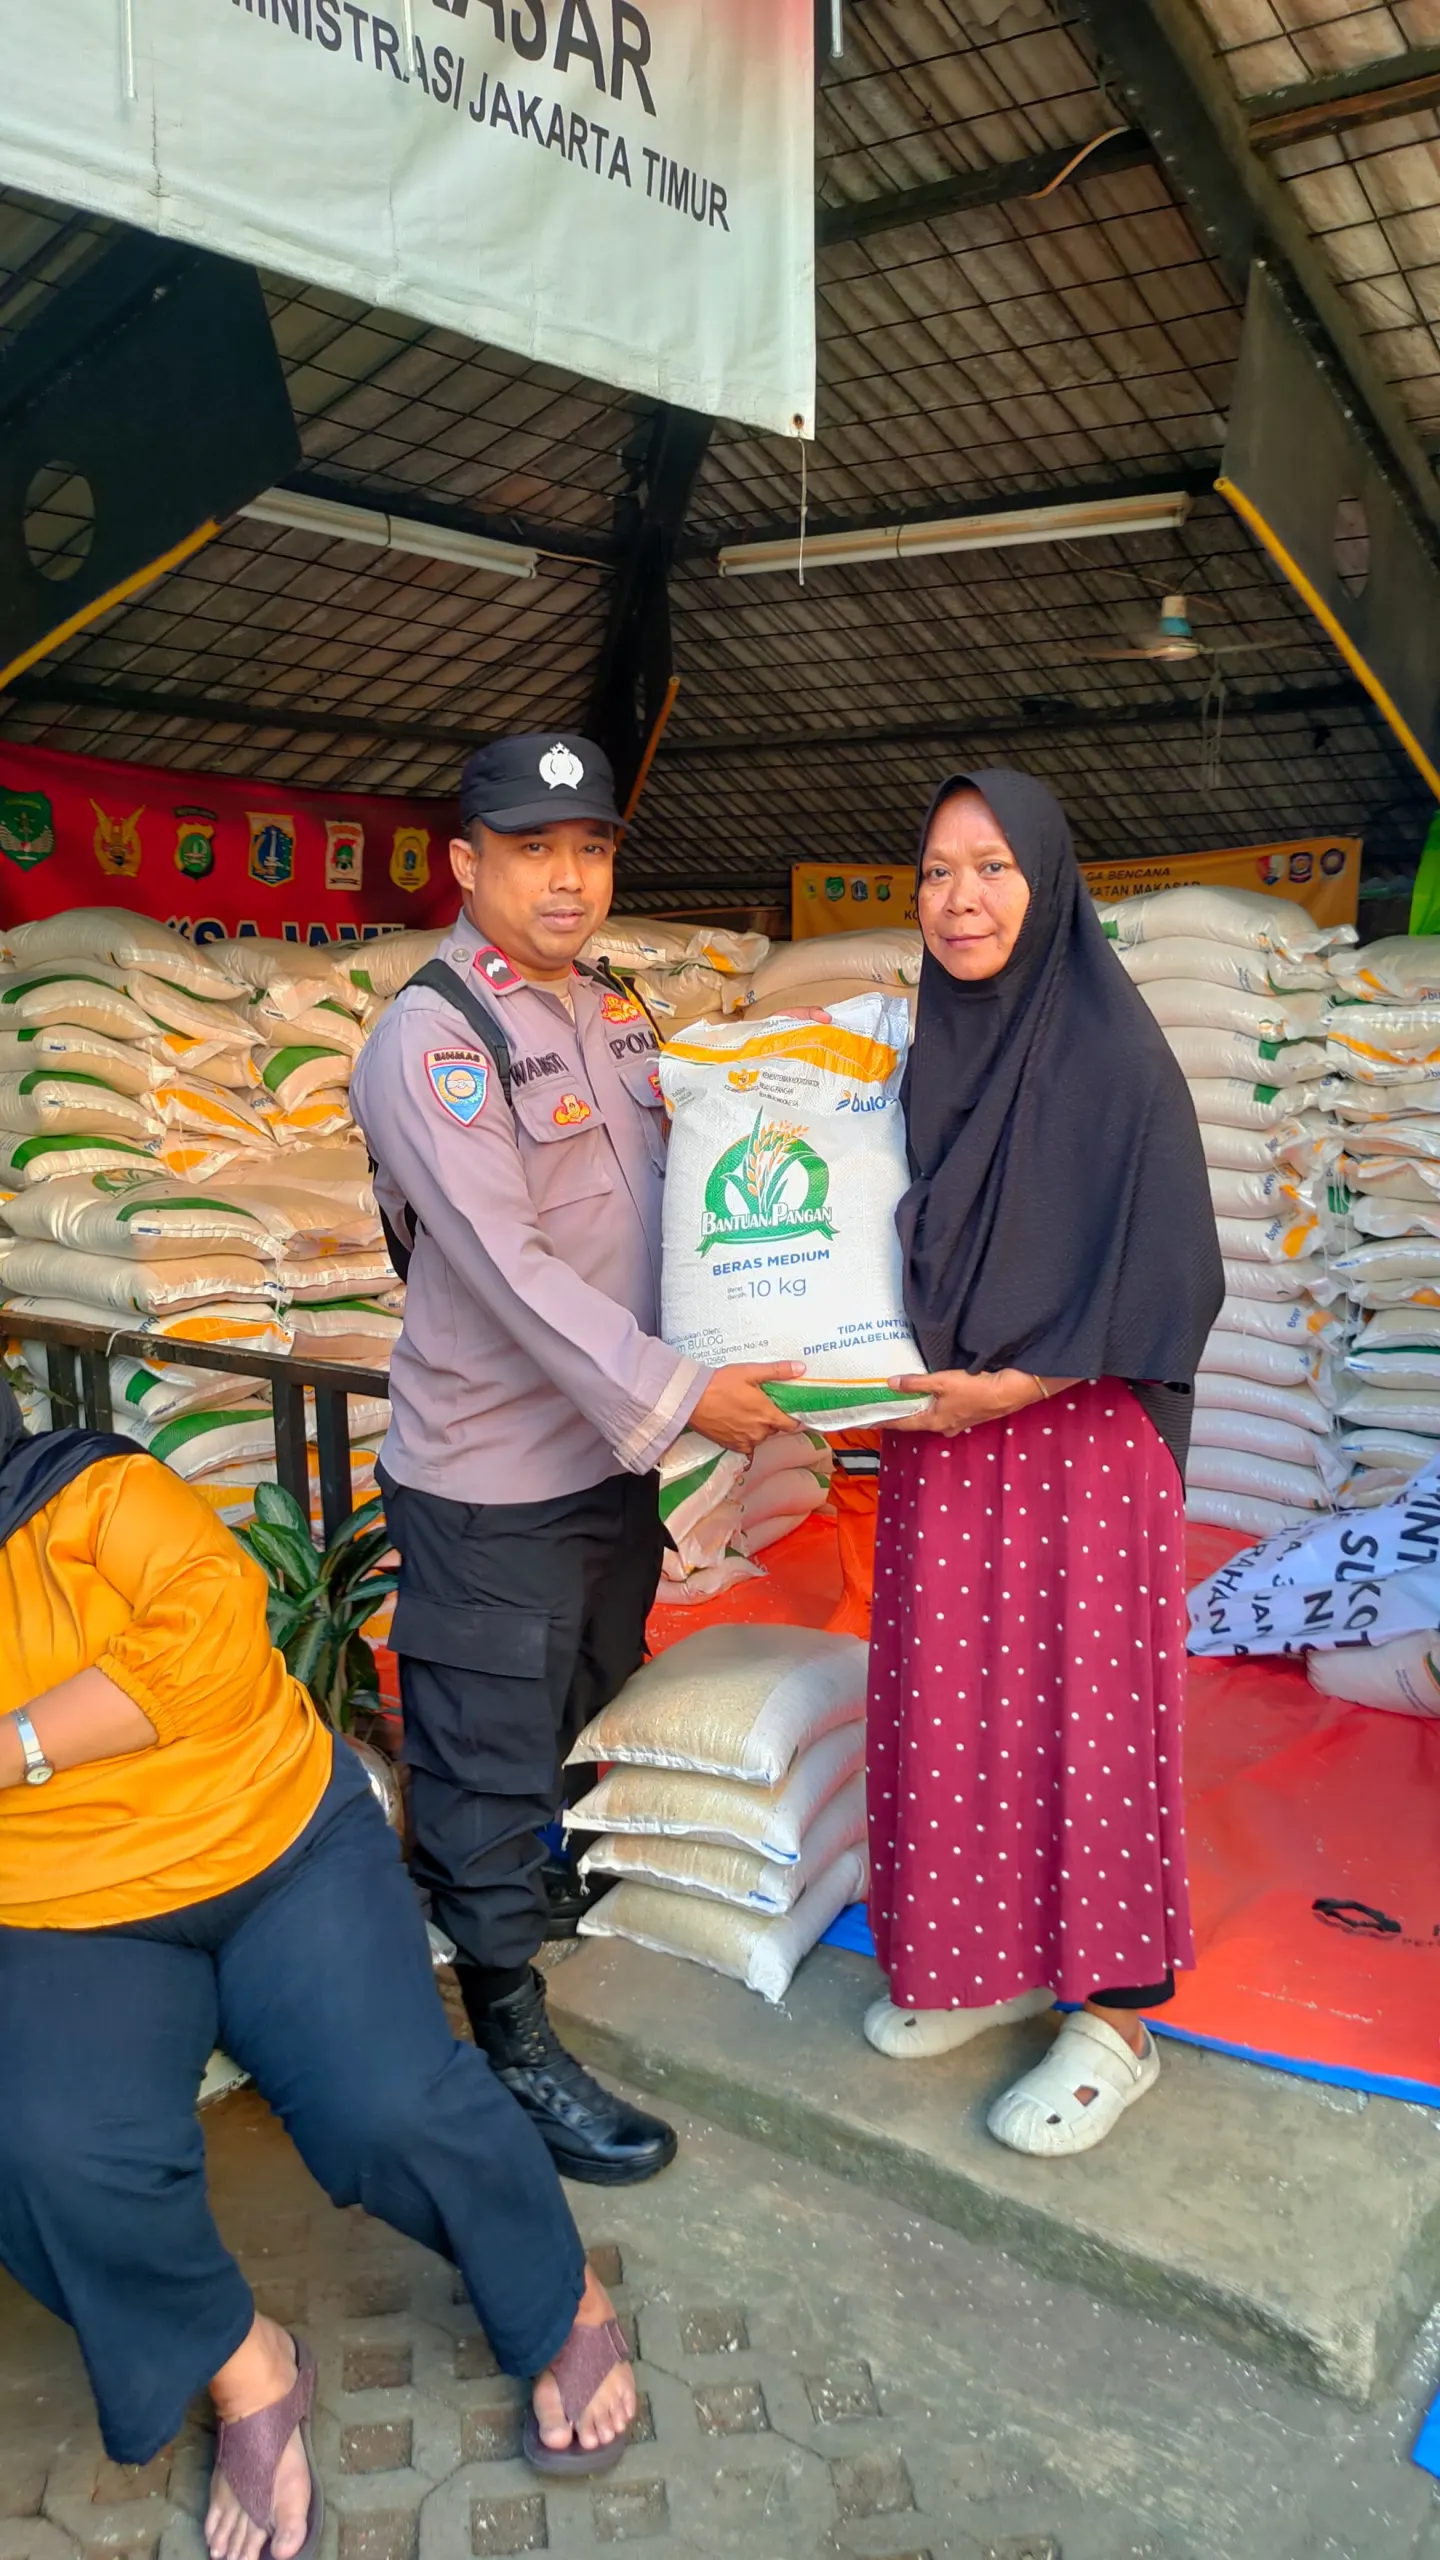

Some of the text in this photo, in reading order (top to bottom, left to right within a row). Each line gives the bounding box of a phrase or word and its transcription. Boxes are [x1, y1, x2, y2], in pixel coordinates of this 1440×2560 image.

[469, 72, 632, 188] JAKARTA
[642, 146, 731, 233] TIMUR
[701, 1202, 833, 1237] BANTUAN PANGAN
[712, 1249, 830, 1276] BERAS MEDIUM
[748, 1279, 771, 1298] 10
[779, 1277, 807, 1297] kg
[837, 1321, 873, 1335] TIDAK
[687, 1334, 724, 1350] BULOG
